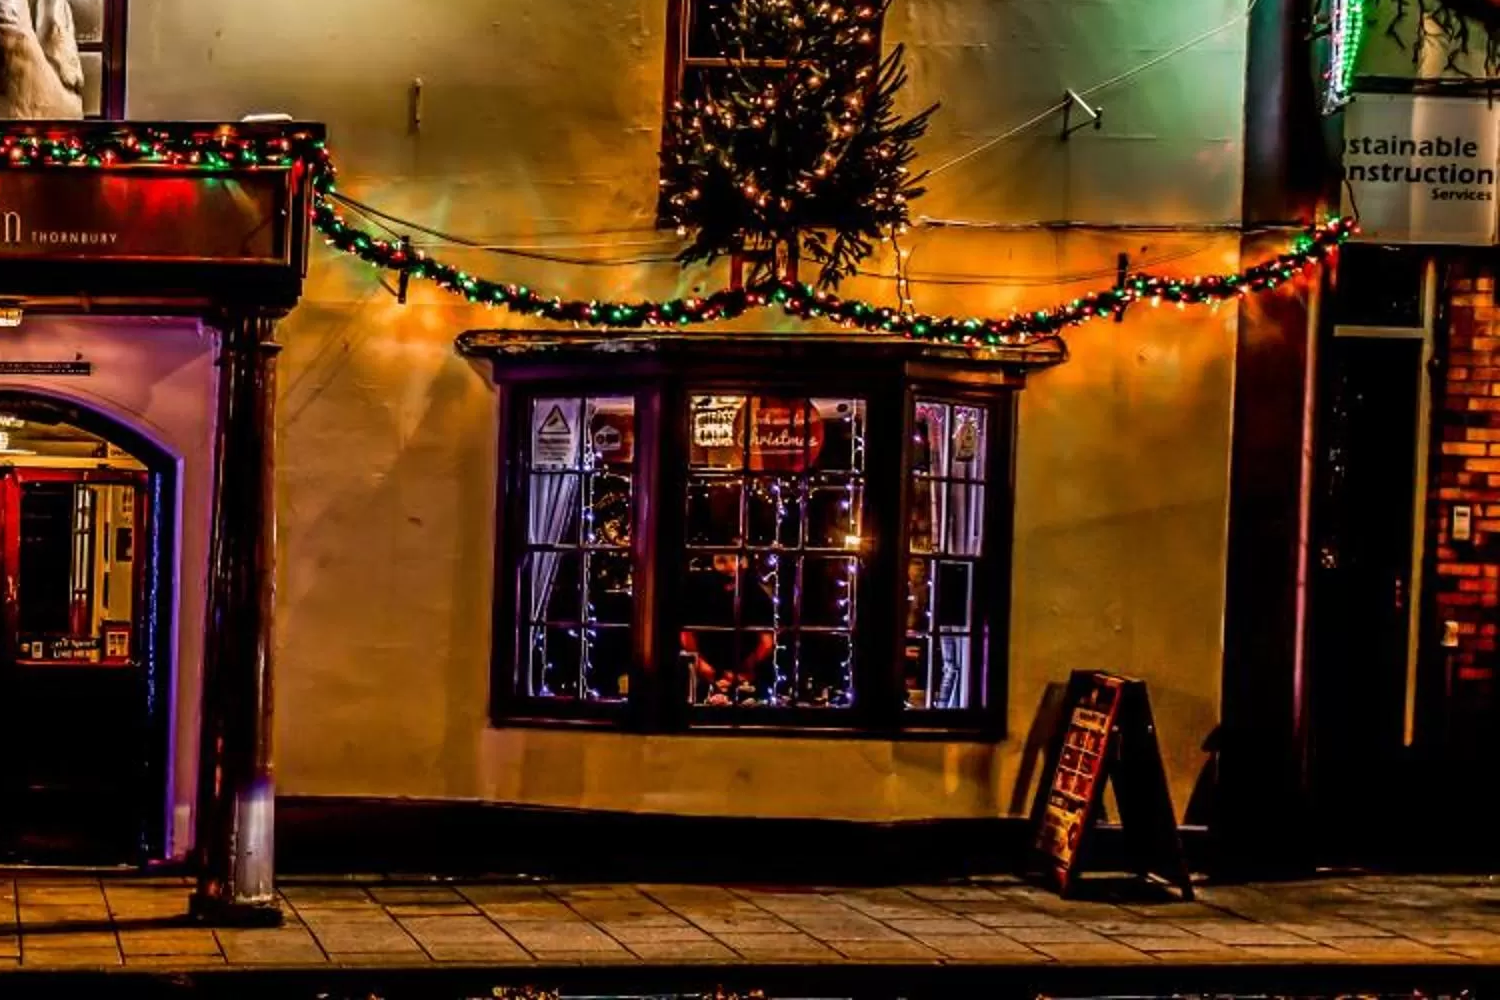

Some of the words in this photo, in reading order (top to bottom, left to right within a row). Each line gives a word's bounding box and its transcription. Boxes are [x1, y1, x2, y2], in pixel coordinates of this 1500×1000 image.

[1343, 135, 1477, 157] stainable
[1431, 187, 1493, 201] Services
[31, 230, 118, 244] THORNBURY
